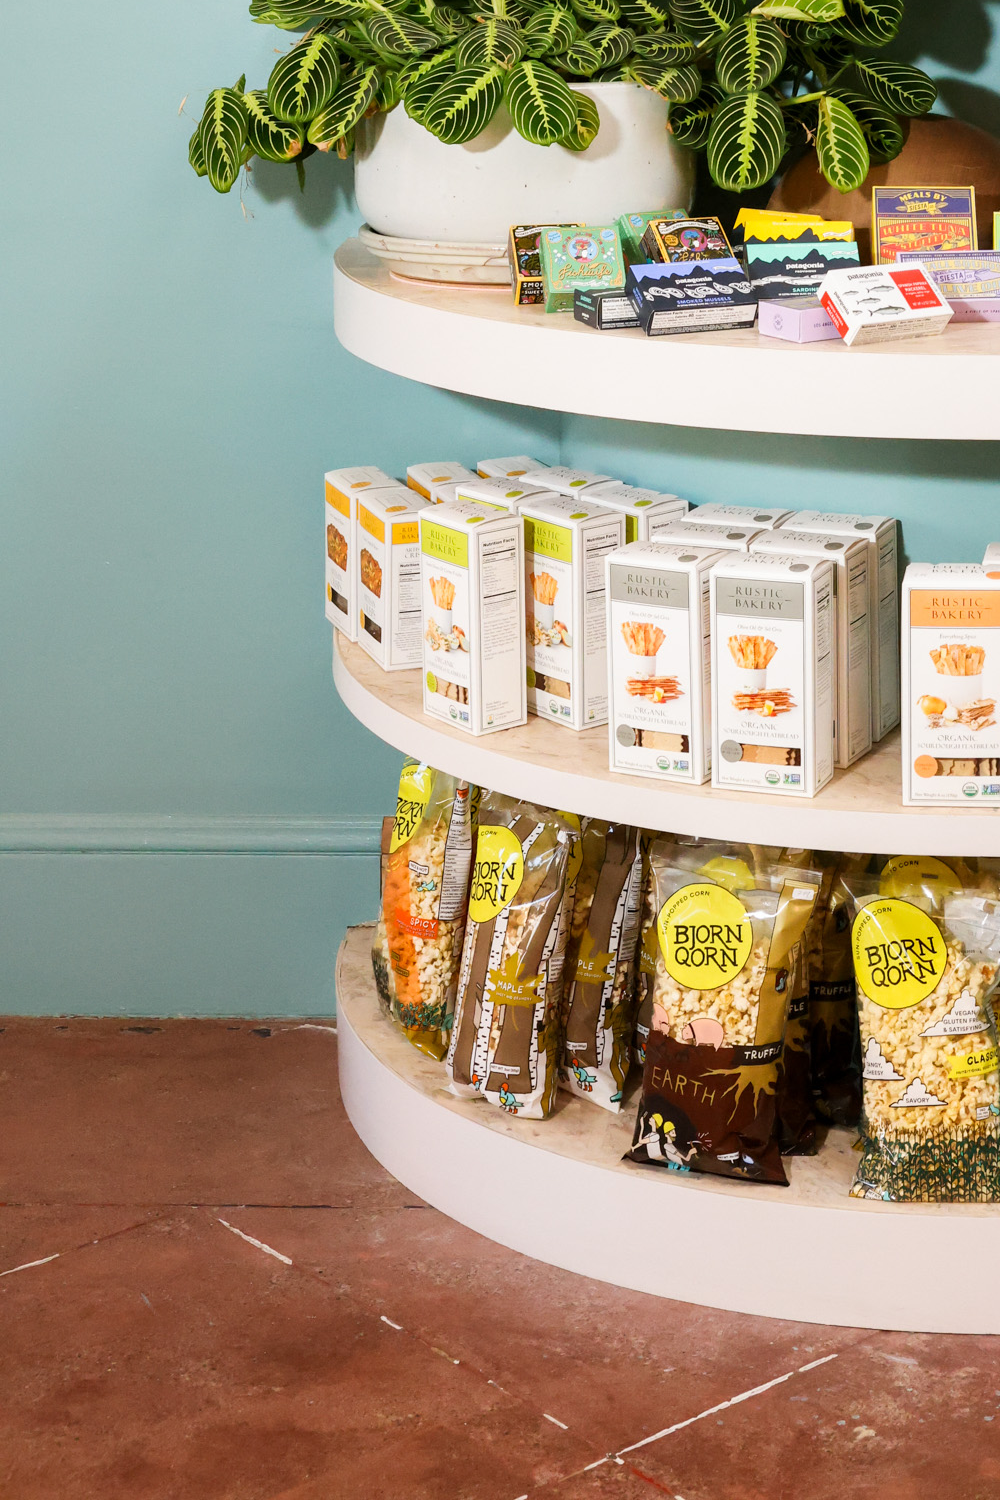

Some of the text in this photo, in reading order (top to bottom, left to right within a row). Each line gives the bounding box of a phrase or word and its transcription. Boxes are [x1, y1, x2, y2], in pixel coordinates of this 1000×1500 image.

[899, 190, 947, 202] MEALS BY
[909, 203, 928, 211] SIESTA
[883, 222, 966, 235] WHITE TUNA
[786, 262, 824, 270] patagonia
[675, 276, 712, 284] patagonia
[847, 272, 883, 281] patagonia
[430, 529, 457, 546] RUSTIC
[430, 541, 457, 557] BAKERY
[627, 573, 671, 588] RUSTIC
[627, 586, 671, 599] BAKERY
[735, 586, 783, 598] RUSTIC
[735, 598, 784, 611] BAKERY
[932, 597, 983, 607] RUSTIC
[932, 609, 983, 619] BAKERY
[634, 707, 667, 716] ORGANIC
[741, 721, 777, 730] ORGANIC
[899, 860, 920, 868] CORN
[410, 917, 437, 930] SPICY
[674, 924, 743, 951] BJORN
[675, 947, 738, 972] QORN
[865, 937, 938, 969] BJORN
[871, 960, 938, 987] QORN
[498, 980, 524, 994] MAPLE
[949, 1024, 982, 1032] SATISFYING
[744, 1046, 780, 1060] TRUFFLE
[652, 1066, 715, 1106] EARTH
